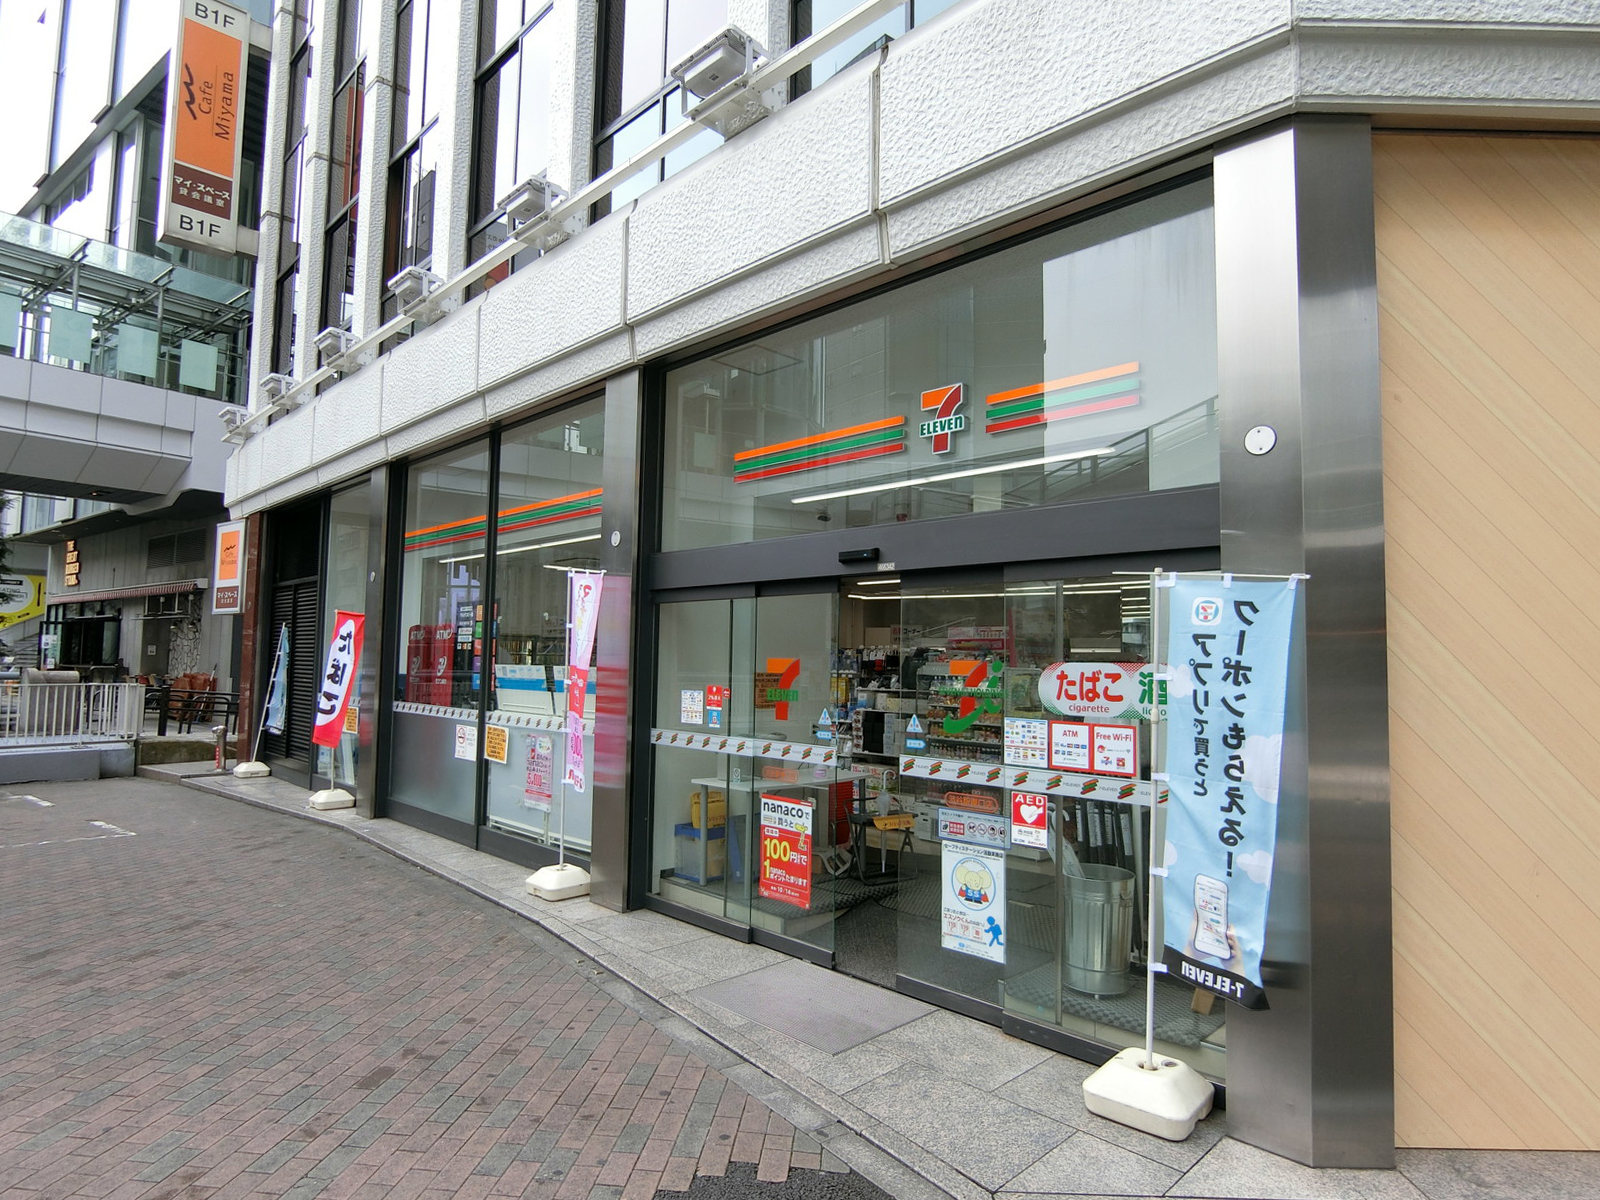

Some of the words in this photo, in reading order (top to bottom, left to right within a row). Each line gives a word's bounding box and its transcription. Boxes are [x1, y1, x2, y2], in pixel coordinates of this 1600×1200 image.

[195, 2, 236, 28] B1F
[198, 81, 214, 115] Cafe
[215, 71, 235, 141] Miyama
[173, 175, 231, 200] マイ・スペース
[180, 214, 222, 238] B1F
[1056, 669, 1124, 703] たばこ
[1068, 703, 1110, 714] cigarette
[1062, 730, 1078, 738] ATM
[1096, 732, 1112, 741] Free
[1113, 733, 1132, 742] Wi-Fi
[1015, 794, 1045, 806] AED
